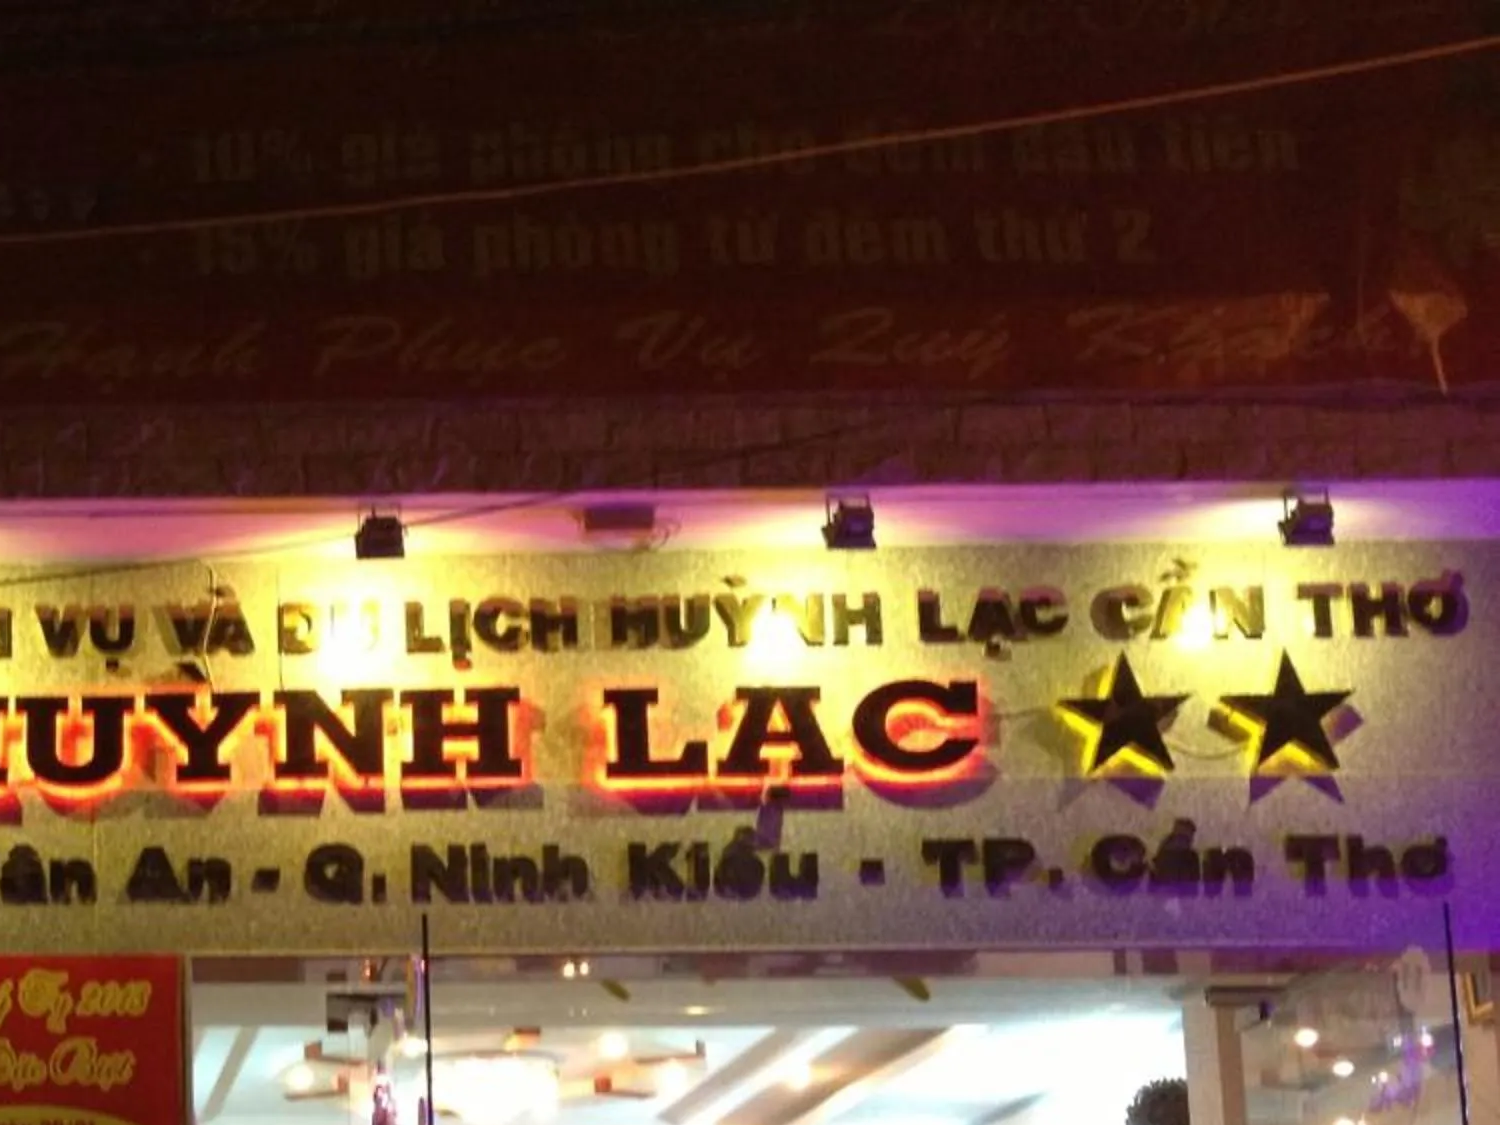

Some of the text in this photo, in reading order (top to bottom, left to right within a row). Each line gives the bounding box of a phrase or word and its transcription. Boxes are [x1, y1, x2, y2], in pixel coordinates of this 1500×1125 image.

[1112, 206, 1156, 264] 2
[35, 603, 136, 671] VỤ
[404, 596, 582, 669] LỊCH
[915, 588, 1070, 660] LẠC
[1295, 570, 1470, 640] THƠ
[126, 848, 232, 902] An
[410, 842, 588, 904] Ninh
